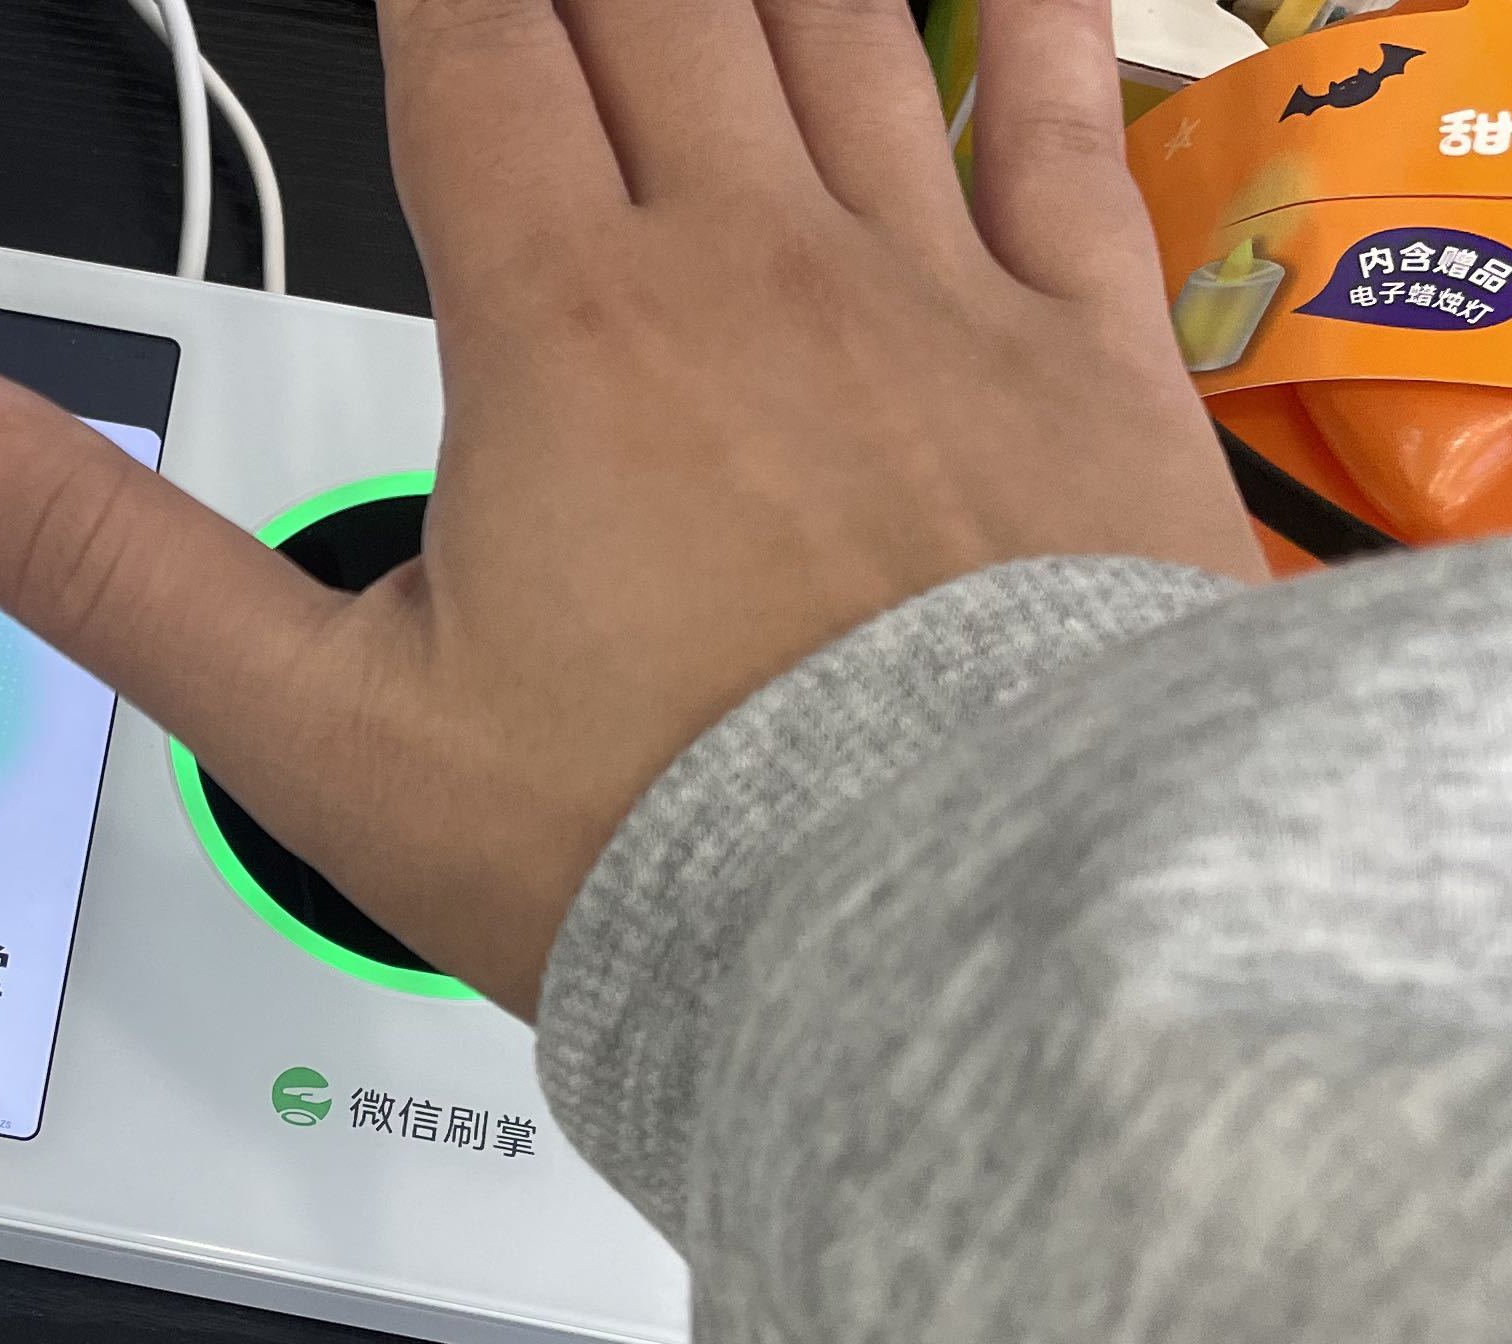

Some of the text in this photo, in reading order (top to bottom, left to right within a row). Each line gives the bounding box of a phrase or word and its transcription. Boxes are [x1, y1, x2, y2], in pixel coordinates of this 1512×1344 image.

[1359, 240, 1512, 295] 内含赠品
[1350, 281, 1494, 326] 电子蜡烛灯
[349, 1087, 537, 1158] 微信刷掌
